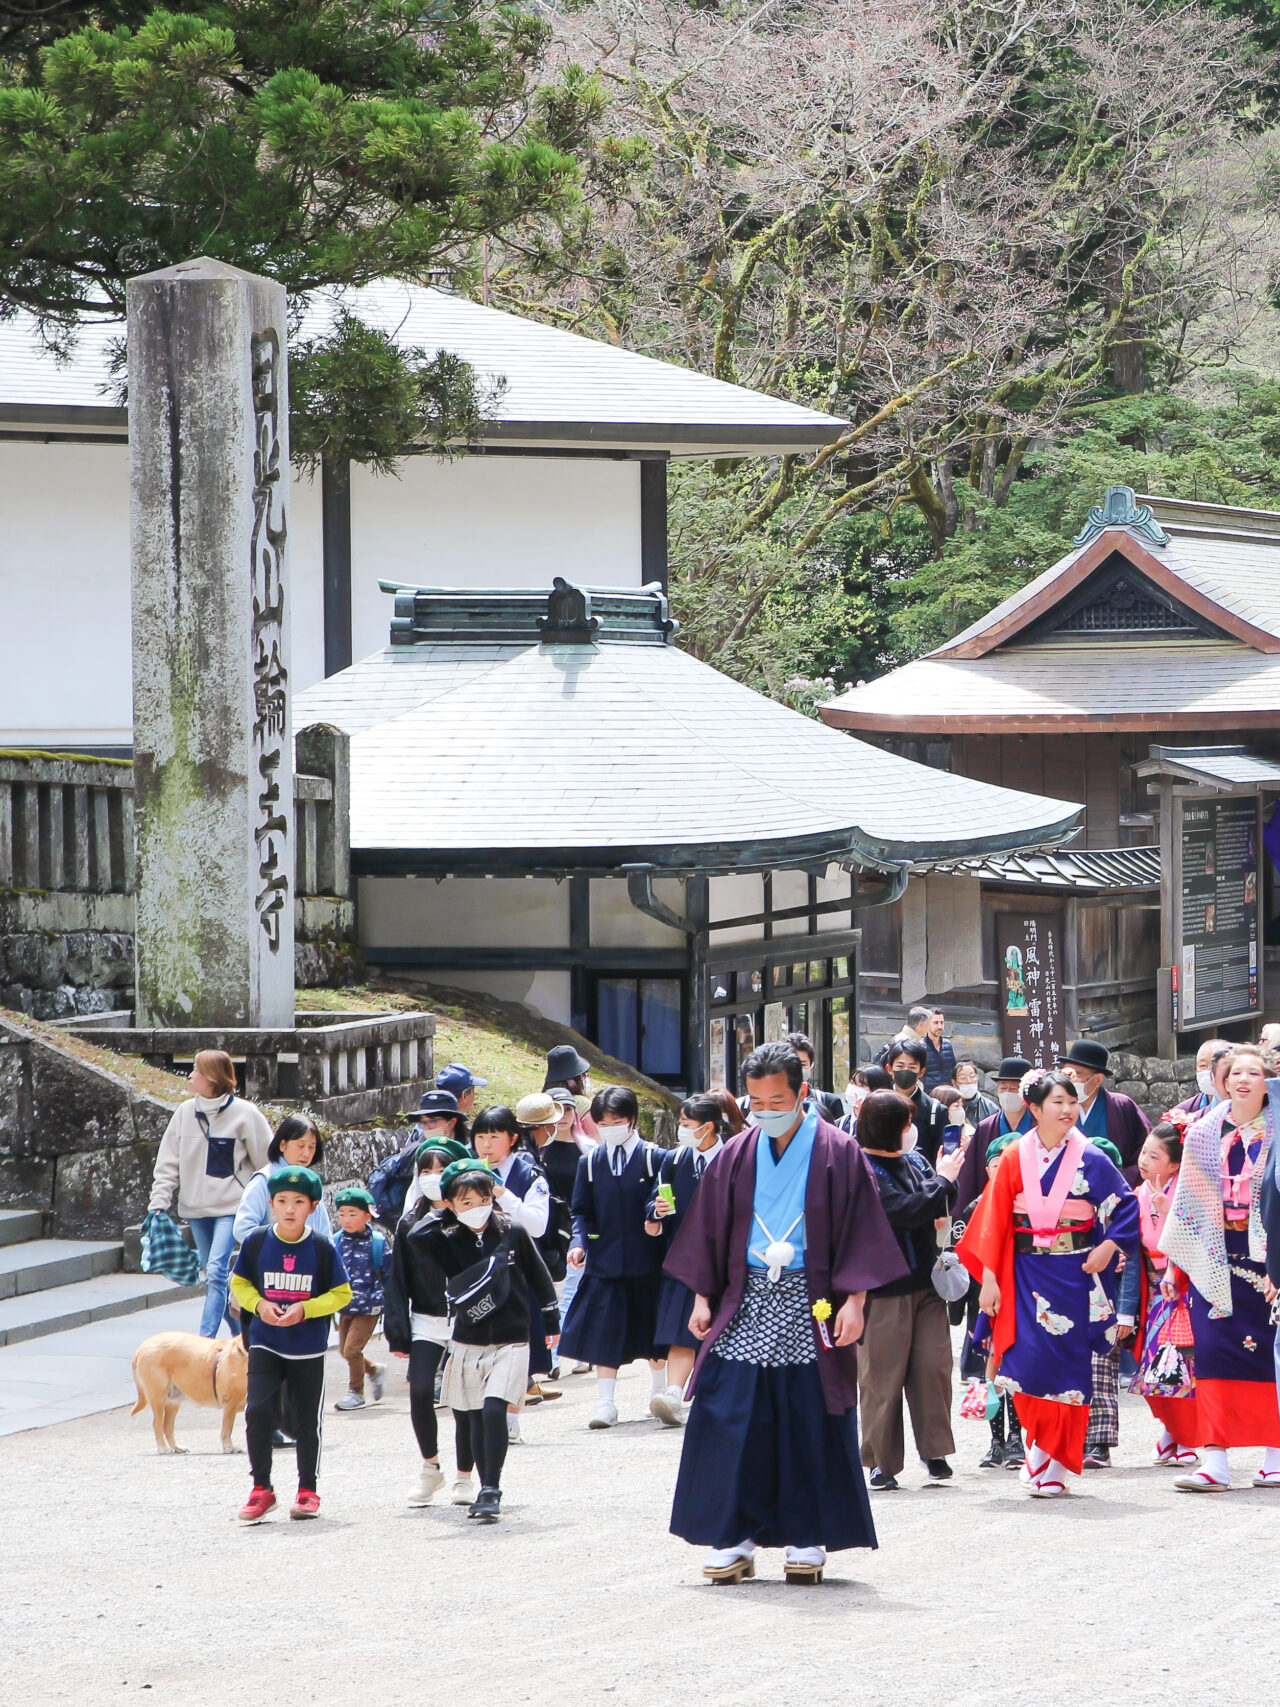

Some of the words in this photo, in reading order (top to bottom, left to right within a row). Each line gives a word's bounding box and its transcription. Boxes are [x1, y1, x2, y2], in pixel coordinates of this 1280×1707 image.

[250, 329, 289, 955] 日光山輪王寺
[264, 1272, 312, 1292] PUMA
